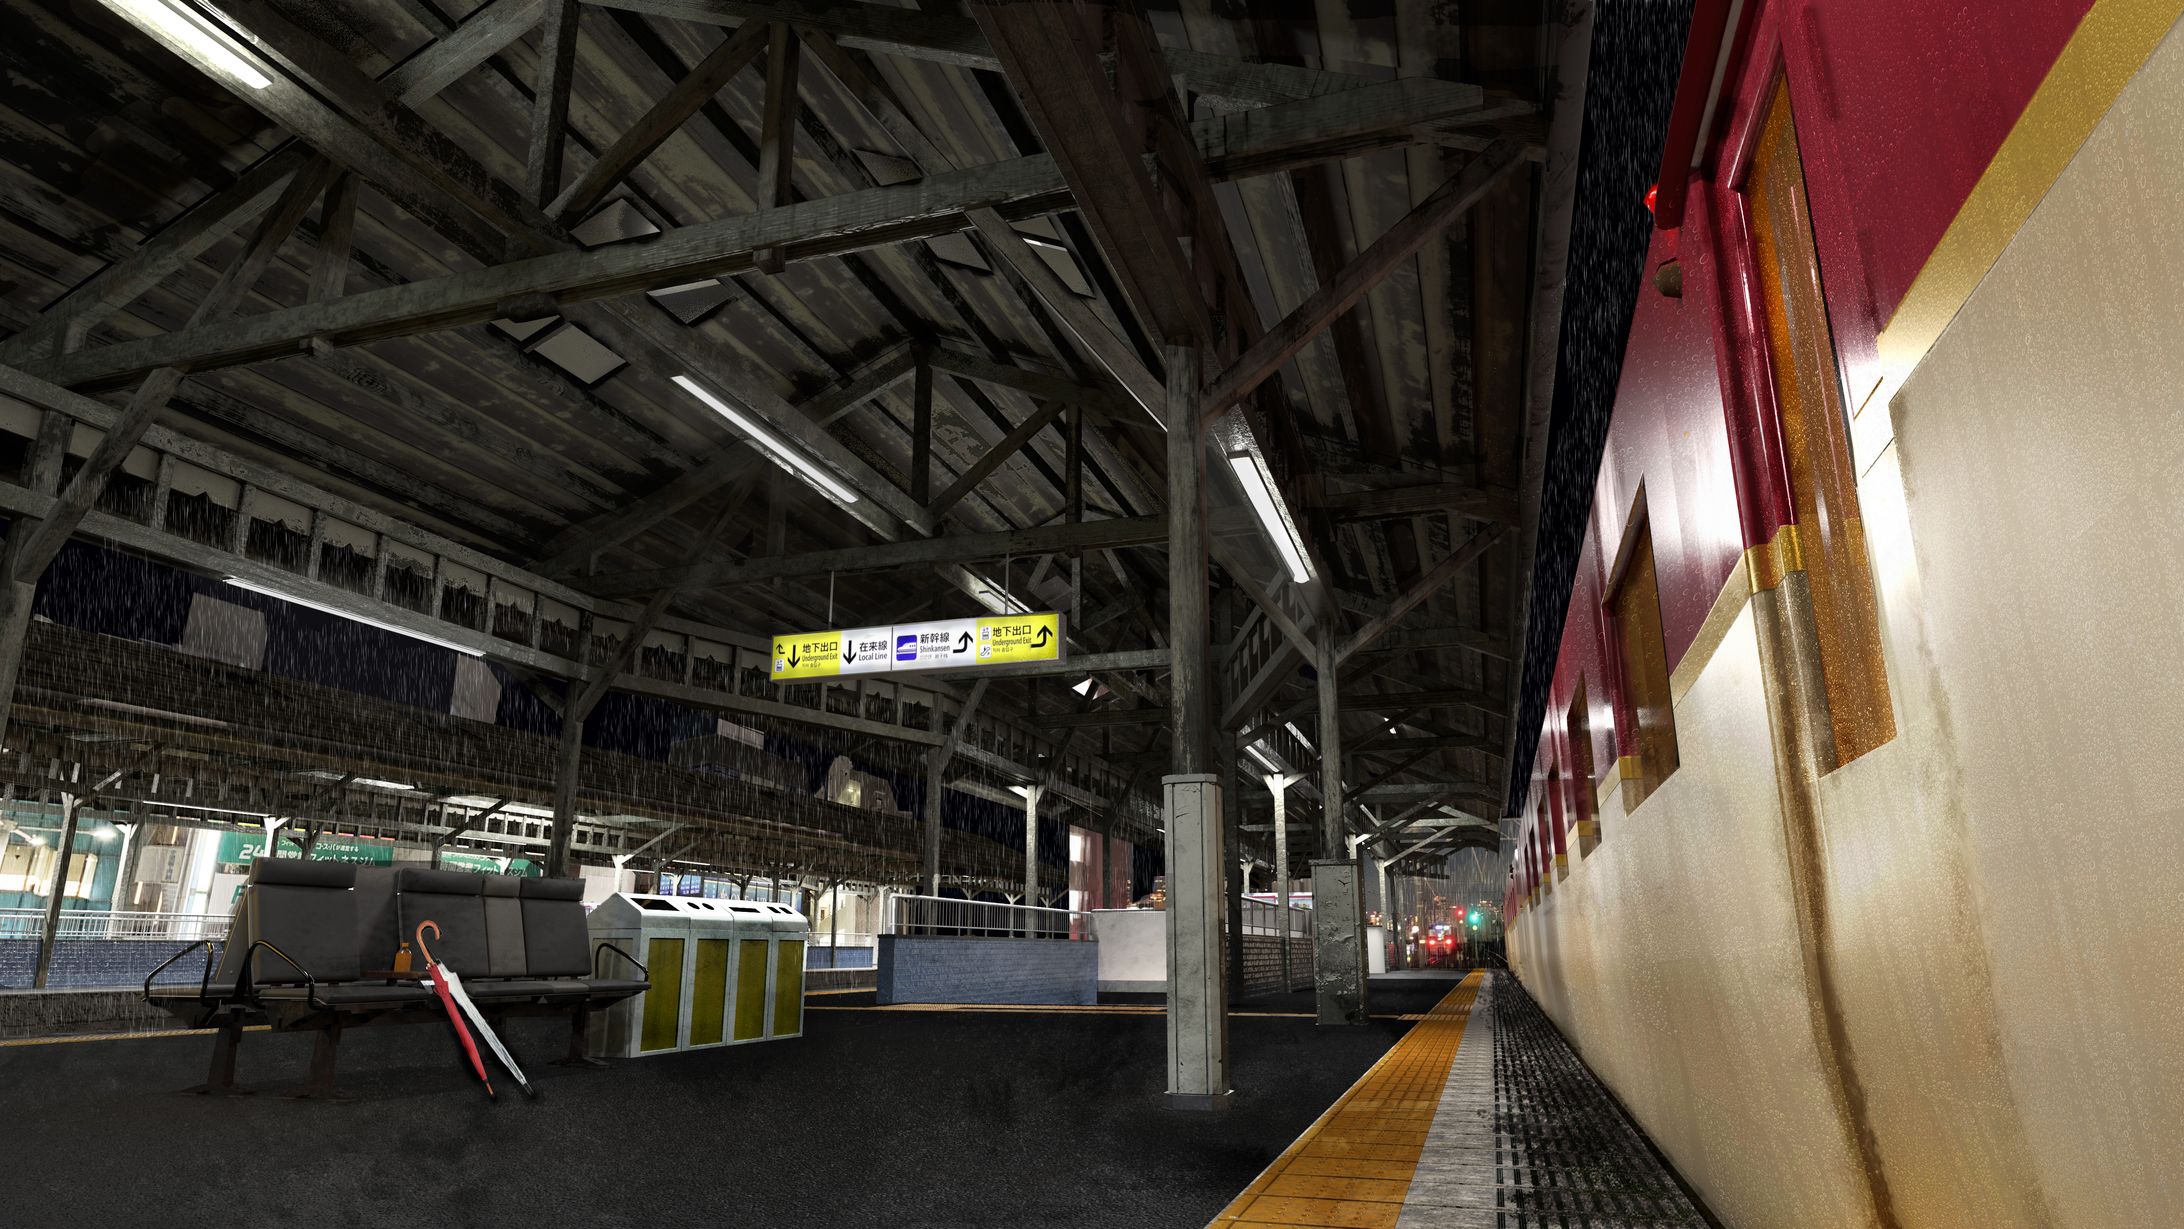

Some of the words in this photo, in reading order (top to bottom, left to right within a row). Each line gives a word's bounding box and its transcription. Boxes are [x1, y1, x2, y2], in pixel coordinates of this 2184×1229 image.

[992, 625, 1031, 637] 地下出口
[919, 632, 950, 644] 新幹線
[992, 637, 1022, 647] Underground
[1022, 636, 1032, 644] Exit
[802, 641, 838, 653] 地下出口
[859, 640, 888, 652] 在来線
[919, 644, 951, 653] Shinkansen
[802, 653, 829, 662] Underground
[829, 652, 838, 660] Exit
[859, 652, 874, 661] Local
[874, 651, 888, 660] Line
